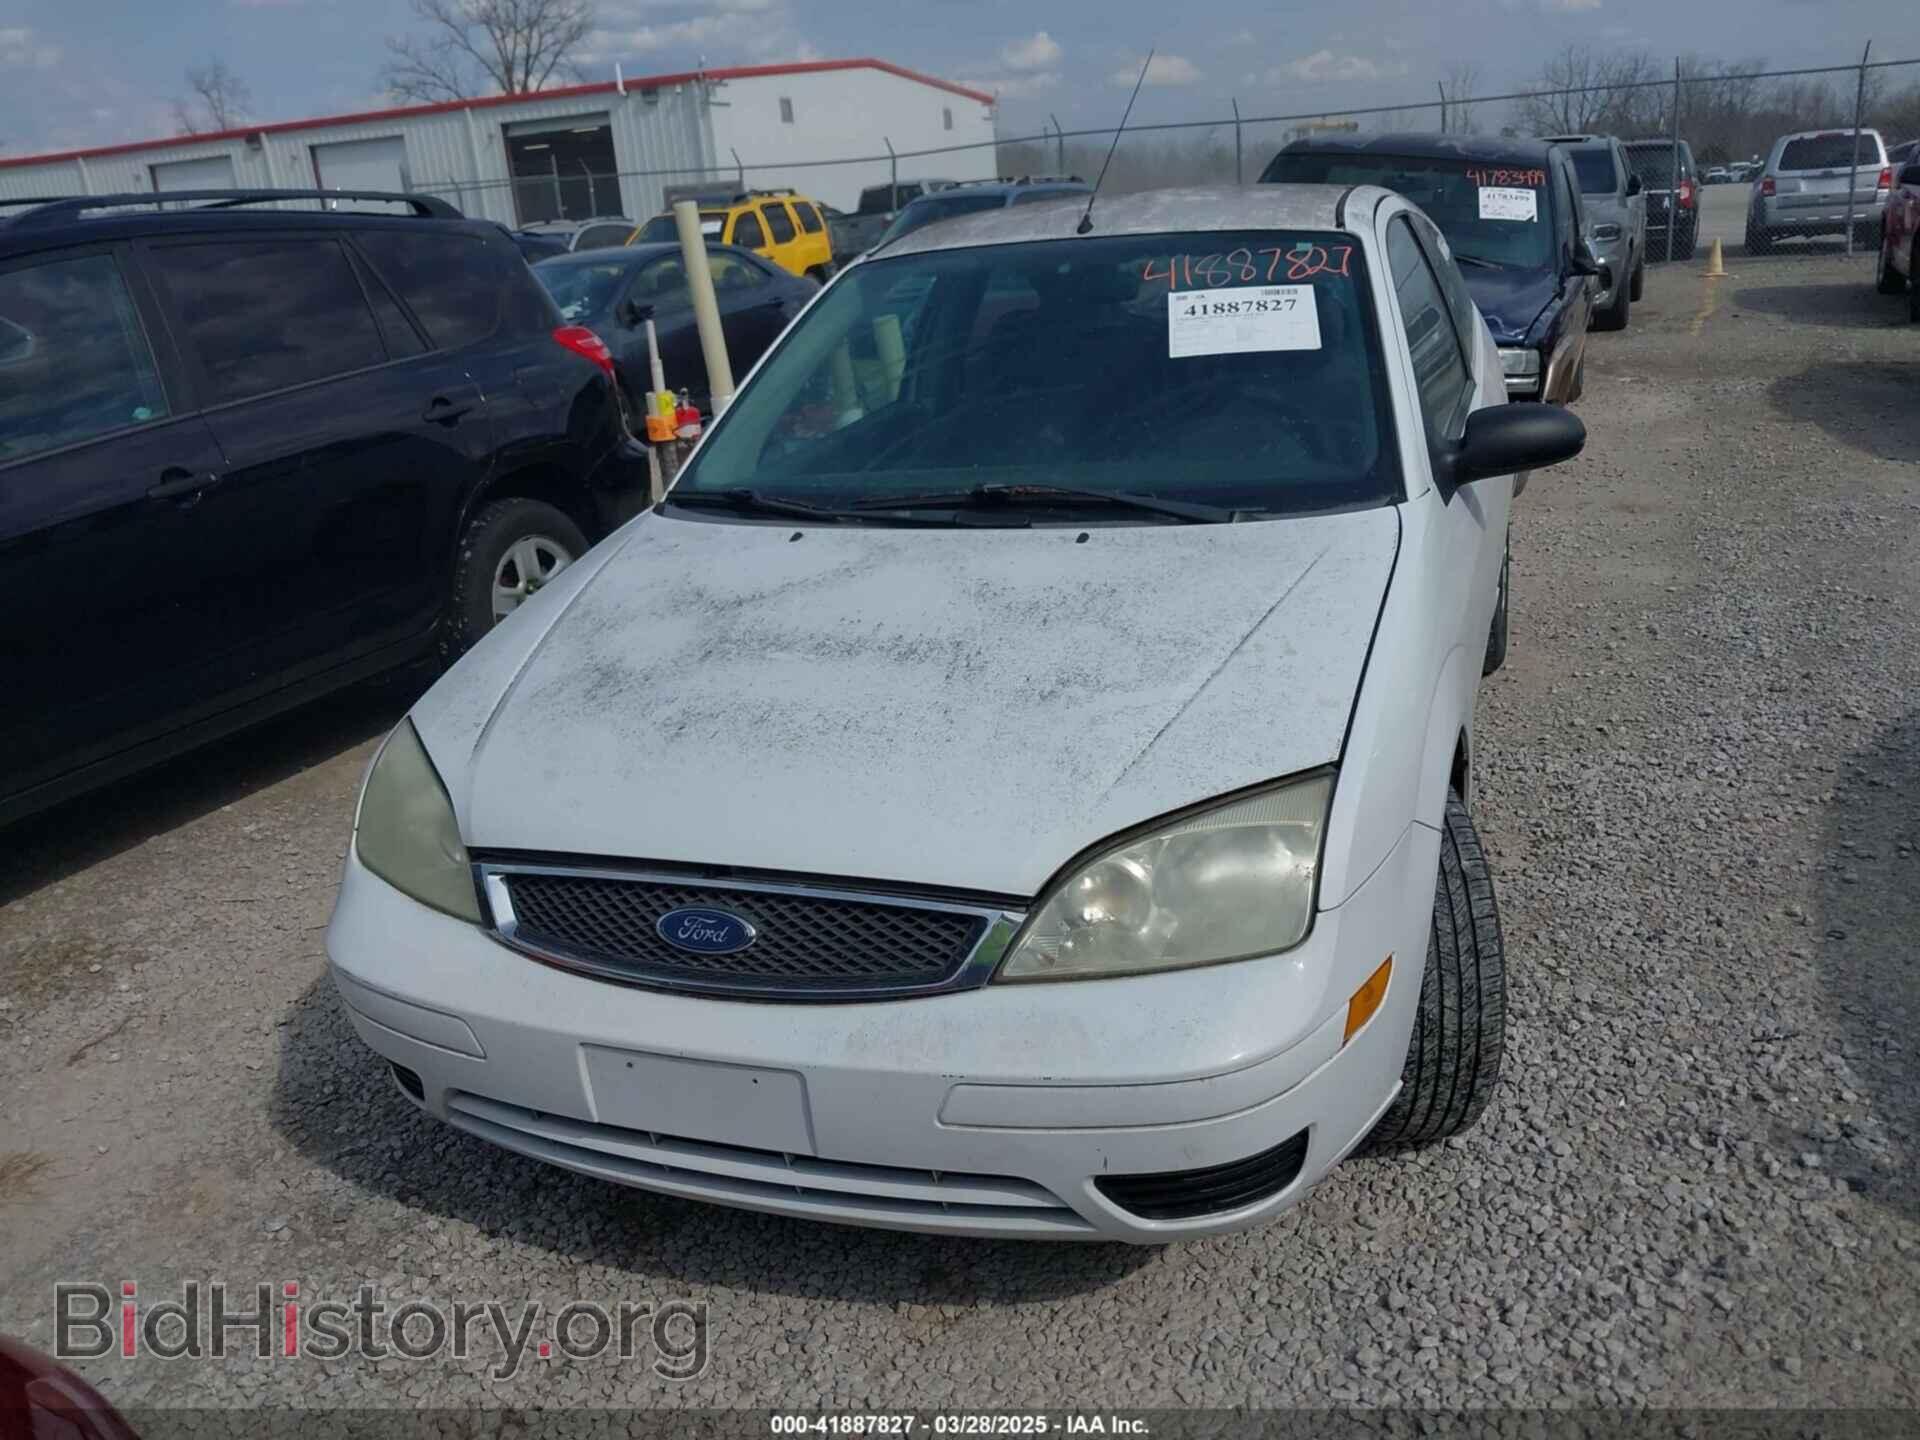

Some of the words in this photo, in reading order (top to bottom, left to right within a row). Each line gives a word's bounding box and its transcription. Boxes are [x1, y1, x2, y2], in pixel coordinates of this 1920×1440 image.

[1143, 246, 1352, 291] 41887827
[1183, 299, 1297, 317] 41887827
[678, 915, 729, 943] Ford
